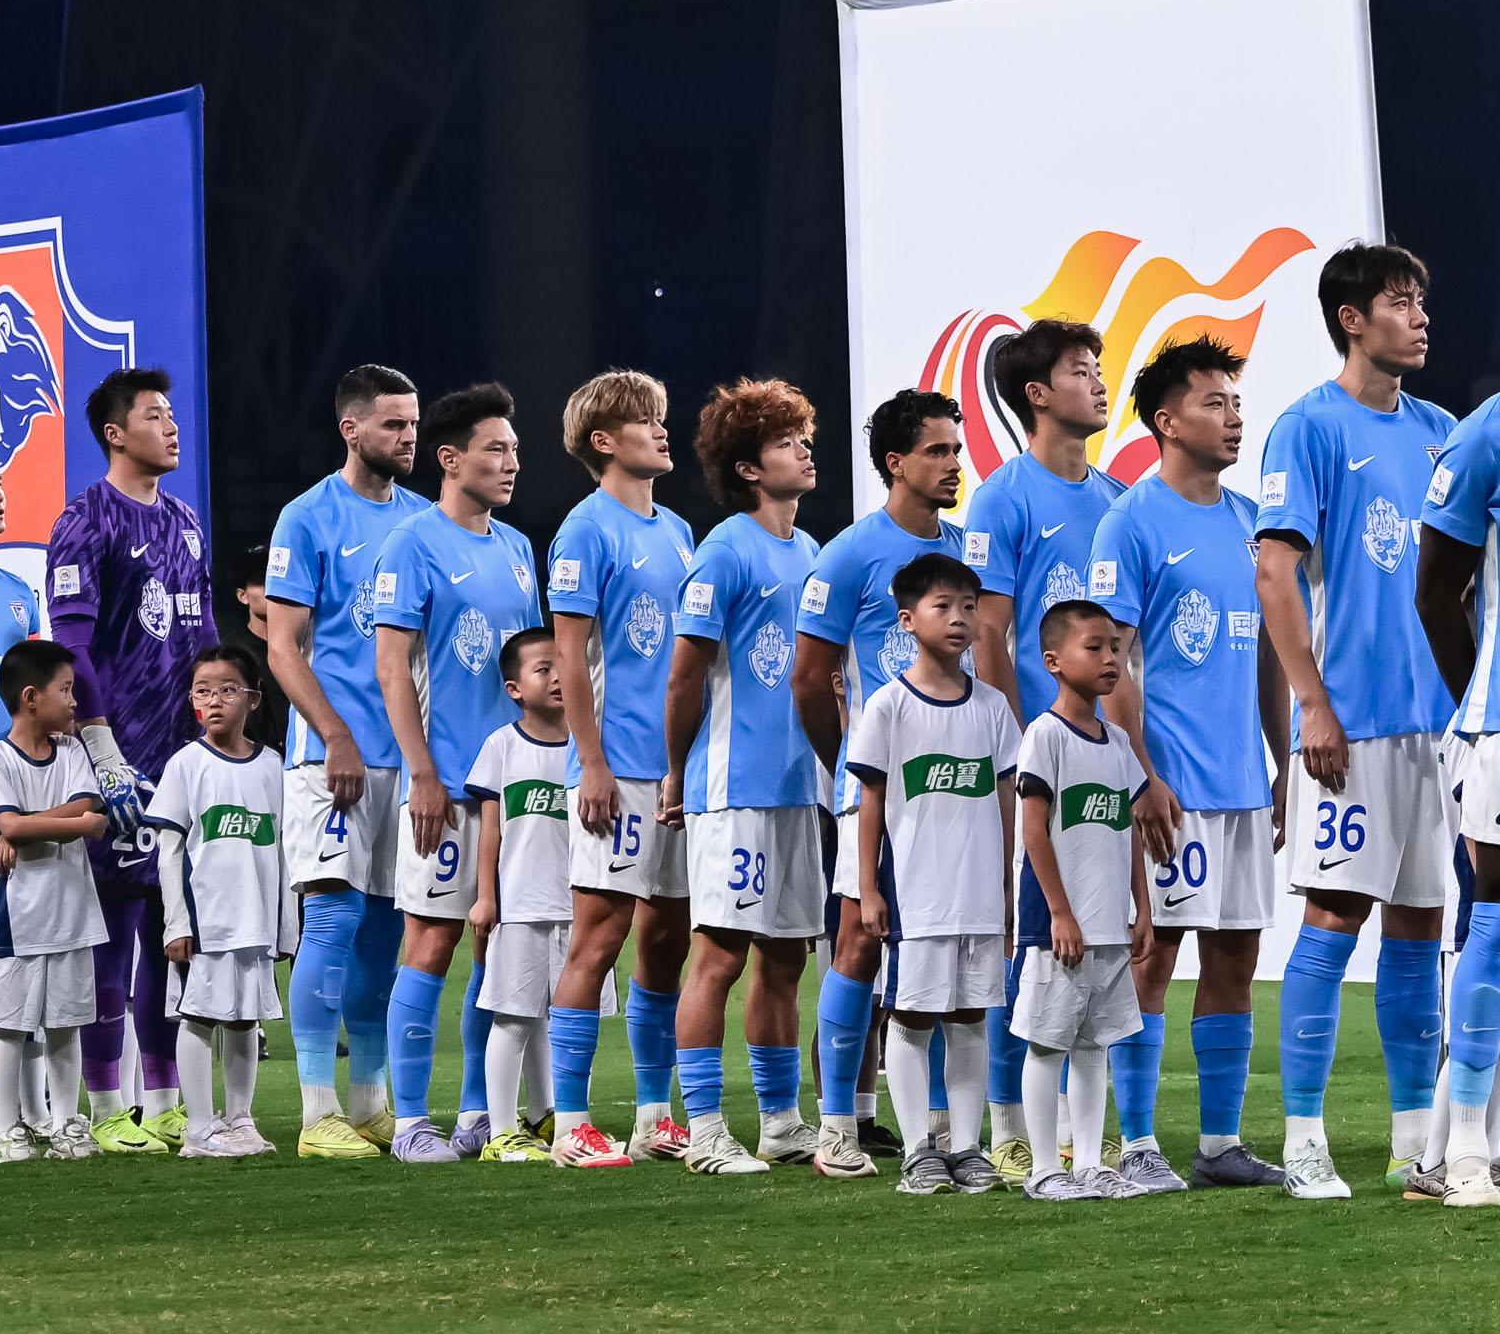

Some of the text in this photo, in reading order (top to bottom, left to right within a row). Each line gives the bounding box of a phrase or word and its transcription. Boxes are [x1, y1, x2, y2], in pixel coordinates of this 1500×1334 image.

[325, 809, 348, 843] 4
[612, 813, 641, 857] 15
[1313, 801, 1367, 853] 36
[435, 840, 459, 882] 9
[727, 848, 767, 896] 38
